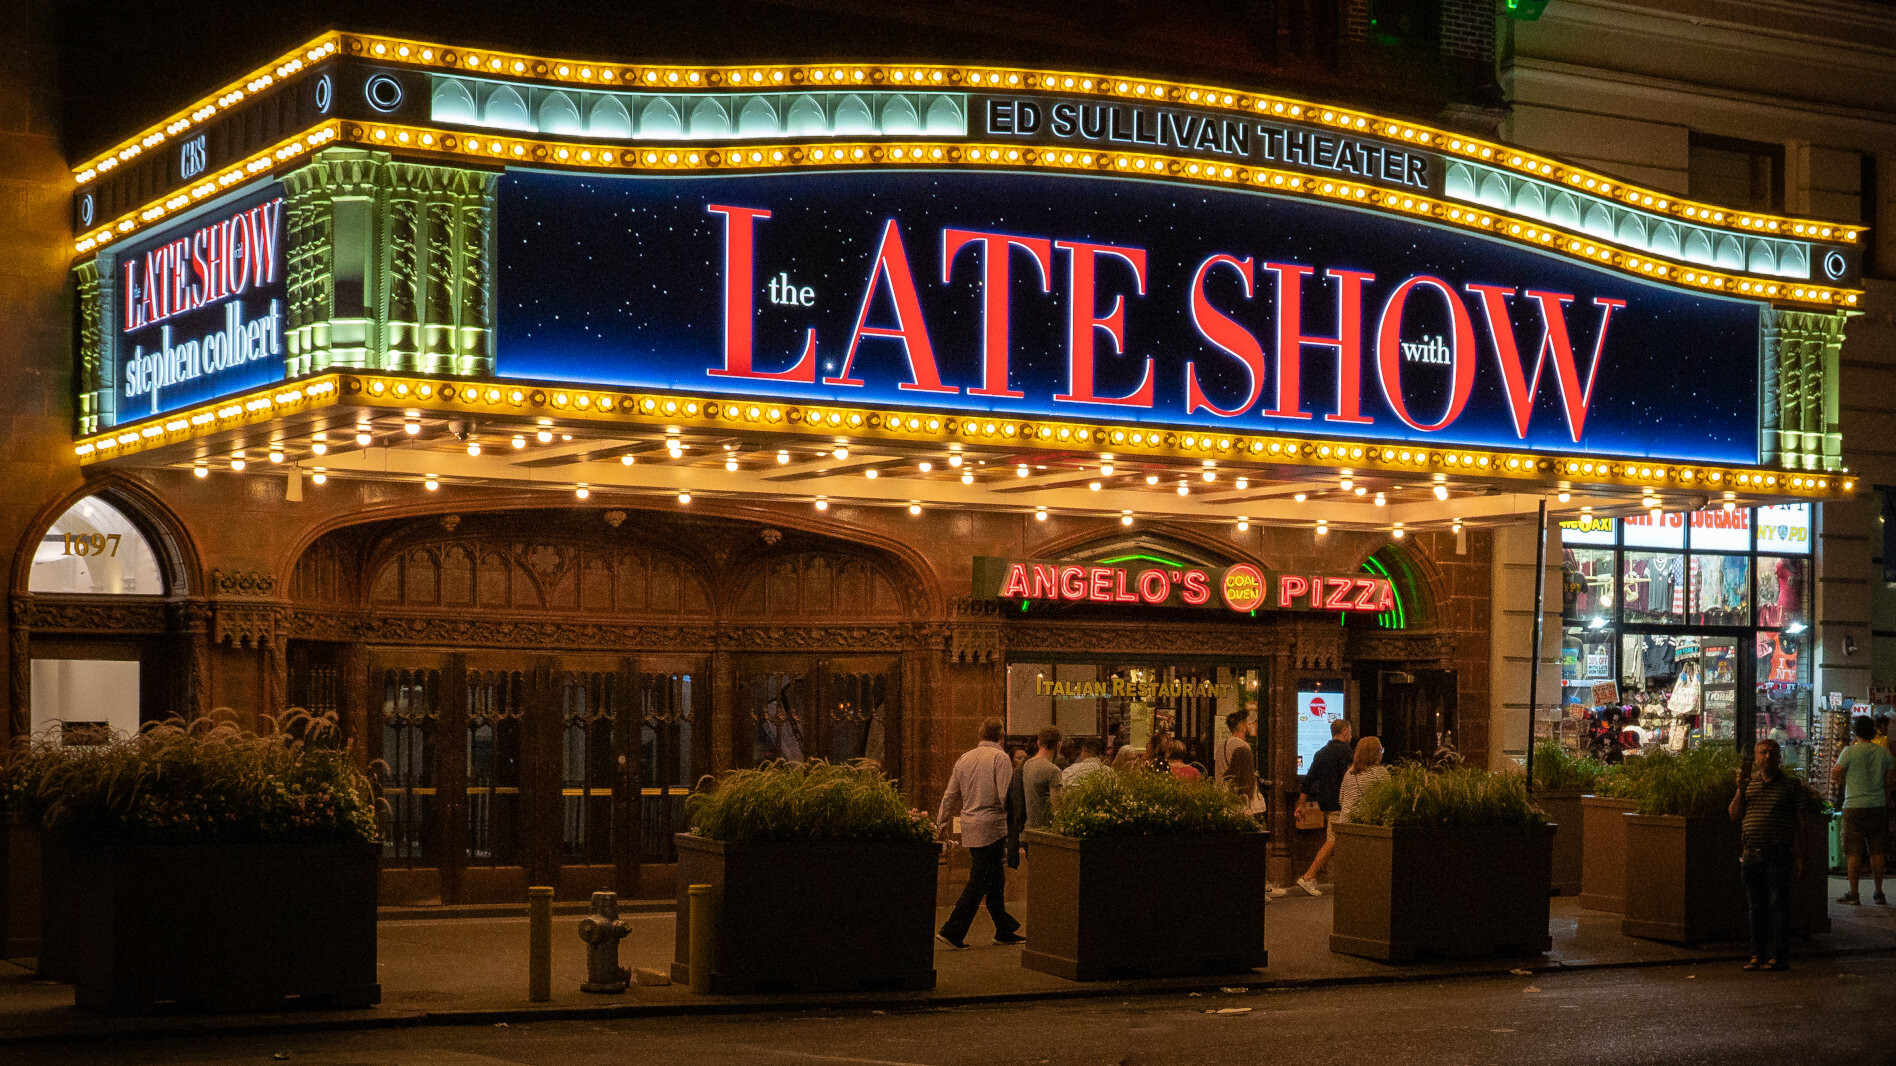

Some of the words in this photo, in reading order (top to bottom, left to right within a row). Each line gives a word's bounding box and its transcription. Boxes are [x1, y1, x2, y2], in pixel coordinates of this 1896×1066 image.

[181, 134, 206, 179] CBS
[986, 100, 1041, 136] ED
[1051, 102, 1250, 156] SULLIVAN
[1257, 125, 1429, 189] THEATER
[123, 236, 191, 332] LATE
[191, 197, 282, 310] SHOW
[768, 273, 815, 306] the
[707, 204, 1154, 408] LATE
[1186, 253, 1627, 443] SHOW
[125, 326, 200, 413] stephen
[201, 299, 278, 374] colbert
[1401, 334, 1451, 365] with
[1690, 507, 1749, 529] LUGGAGE
[61, 532, 122, 557] 1697
[1003, 563, 1211, 606] ANGELO'S
[1280, 575, 1395, 611] PIZZA
[1226, 575, 1259, 587] COAL
[1227, 588, 1259, 600] OVEN
[1776, 668, 1797, 680] NY
[1779, 658, 1785, 668] I
[1036, 676, 1107, 696] ITALIAN
[1112, 678, 1230, 698] RESTAURANT
